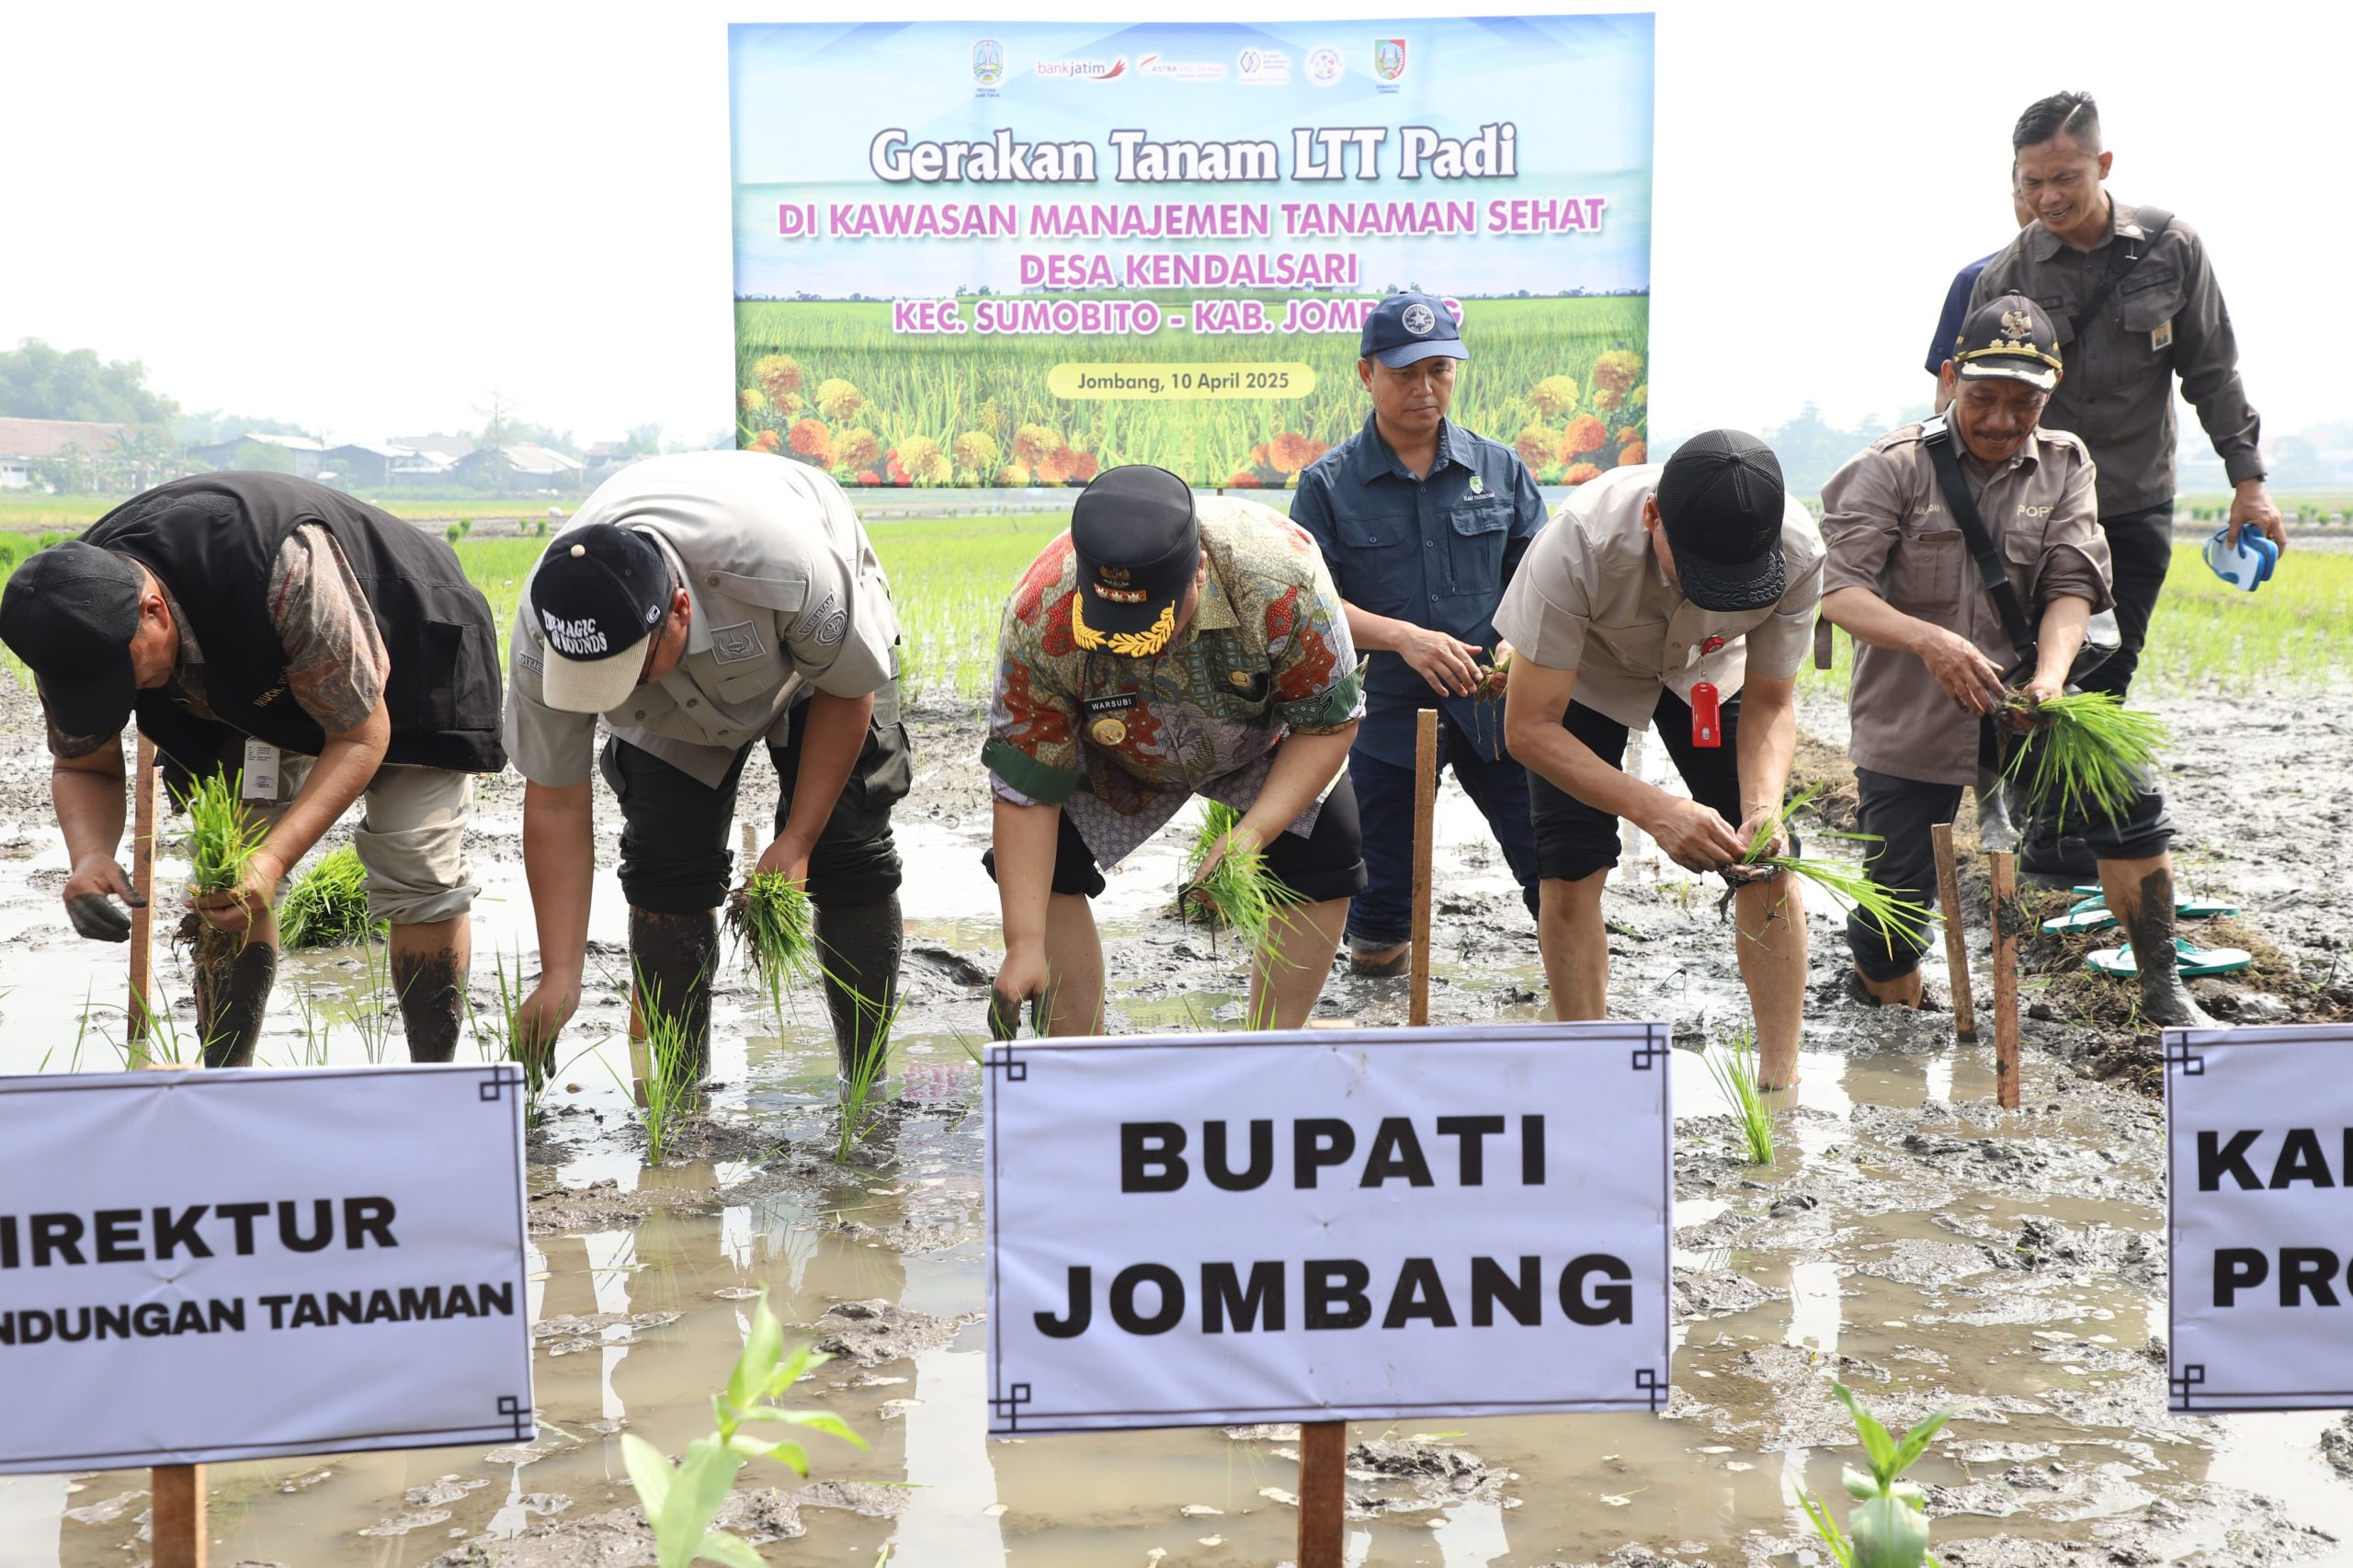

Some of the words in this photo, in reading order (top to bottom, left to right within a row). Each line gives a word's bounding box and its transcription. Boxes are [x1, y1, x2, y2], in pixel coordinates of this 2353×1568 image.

[1038, 62, 1105, 76] bankjatim
[870, 129, 1097, 184] Gerakan
[1108, 130, 1280, 183] Tanam
[1291, 128, 1387, 181] LTT
[1398, 123, 1518, 180] Padi
[779, 205, 815, 235] DI
[830, 204, 1016, 236] KAWASAN
[1029, 204, 1268, 236] MANAJEMEN
[1281, 201, 1475, 234] TANAMAN
[1488, 199, 1605, 232] SEHAT
[1020, 255, 1114, 286] DESA
[1126, 254, 1357, 286] KENDALSARI
[895, 301, 964, 332] KEC.
[976, 301, 1159, 333] SUMOBITO
[1195, 301, 1272, 331] KAB.
[1078, 372, 1165, 394] Jombang,
[1172, 373, 1192, 389] 10
[1198, 372, 1239, 392] April
[1246, 372, 1289, 388] 2025
[556, 618, 596, 639] MAGIC
[801, 596, 835, 634] KEMENTAN
[517, 654, 544, 673] DITJE
[1091, 699, 1131, 710] WARSUBI
[1120, 1114, 1546, 1194] BUPATI
[2212, 1247, 2353, 1308] PR
[258, 1282, 514, 1330] TANAMAN
[1032, 1253, 1633, 1339] JOMBANG
